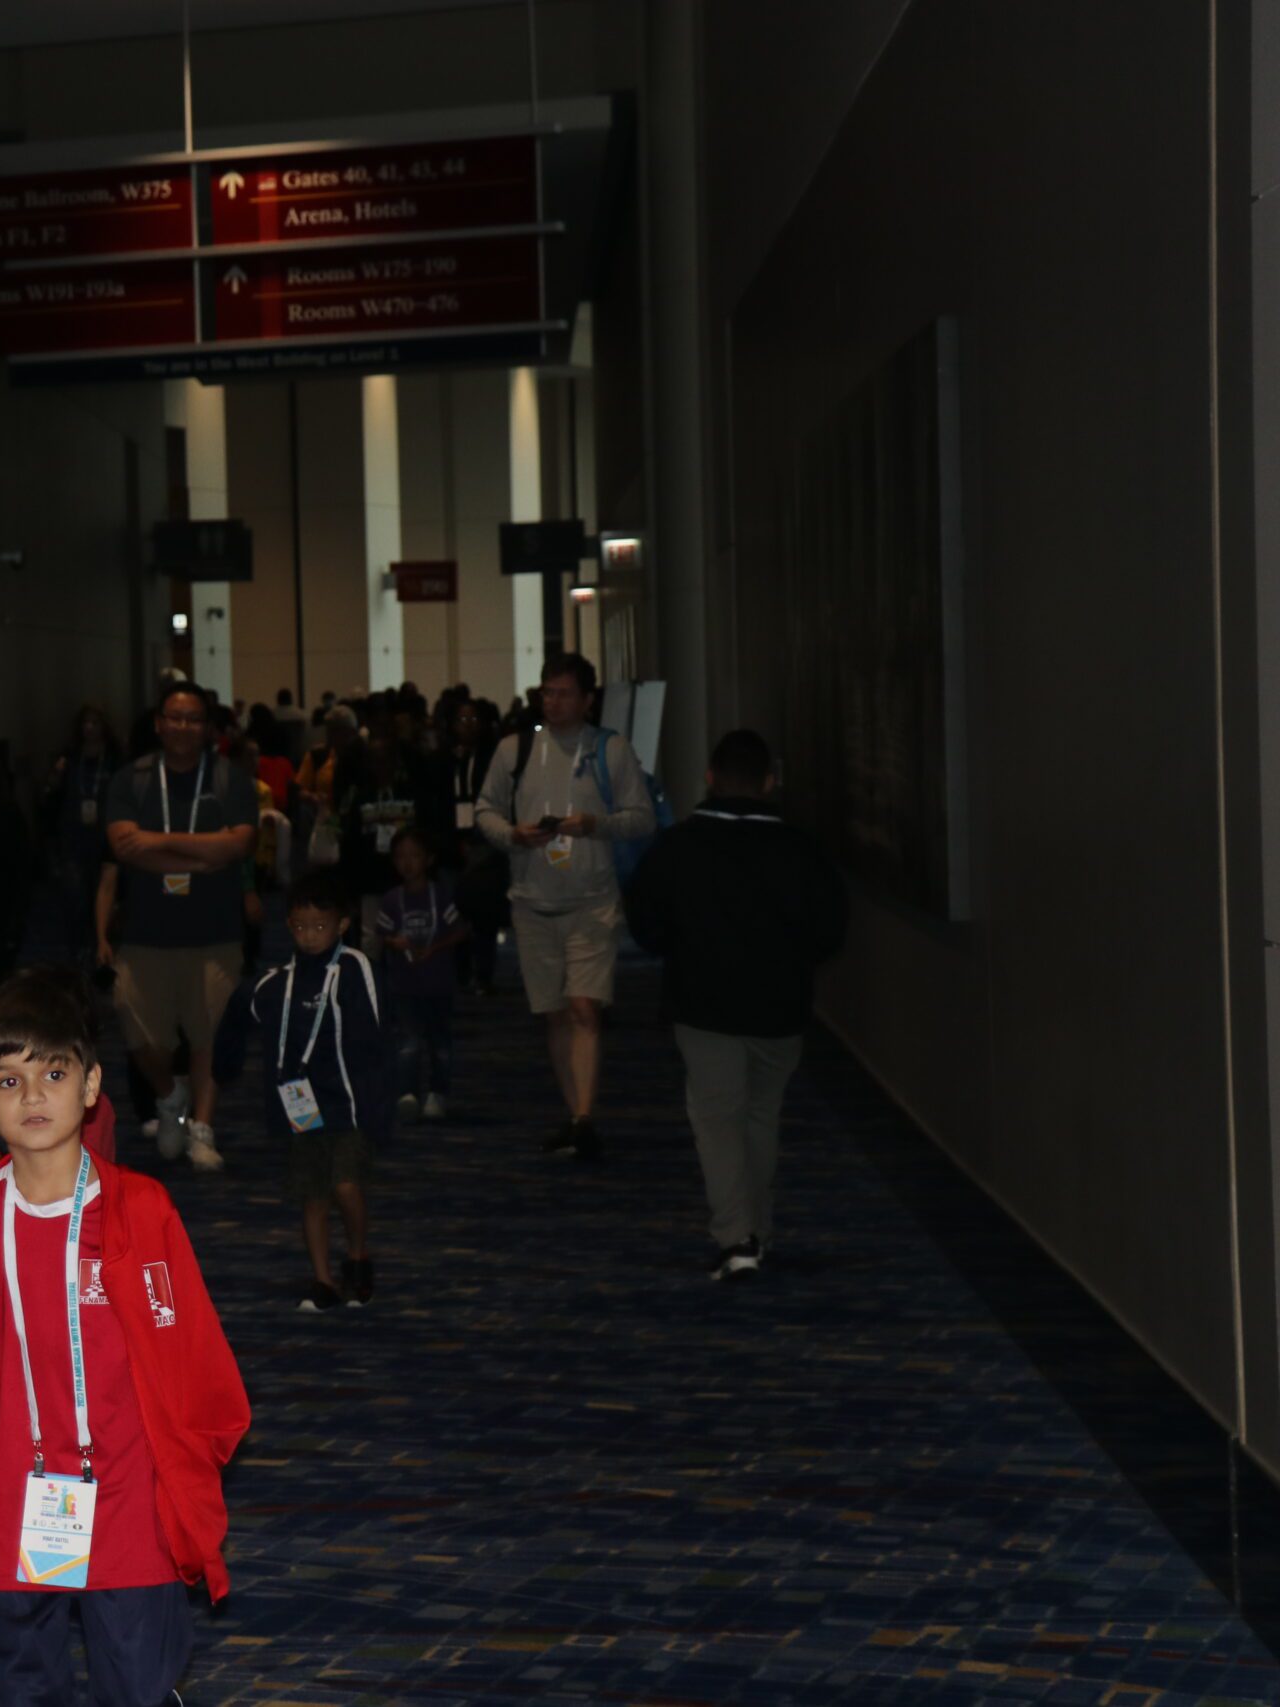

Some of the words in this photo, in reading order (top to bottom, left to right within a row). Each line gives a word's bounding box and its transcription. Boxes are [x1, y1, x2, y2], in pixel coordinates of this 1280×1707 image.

[282, 169, 340, 190] Gates
[343, 166, 373, 186] 40,
[443, 157, 467, 176] 44
[24, 187, 116, 208] Ballroom,
[121, 178, 173, 201] W375
[284, 203, 350, 229] Arena,
[354, 197, 417, 221] Hotels
[7, 227, 38, 248] F1,
[41, 224, 67, 245] F2
[286, 265, 355, 287] Rooms
[287, 301, 357, 324] Rooms
[235, 353, 269, 369] West
[273, 351, 327, 368] Building
[76, 1392, 85, 1408] 2023
